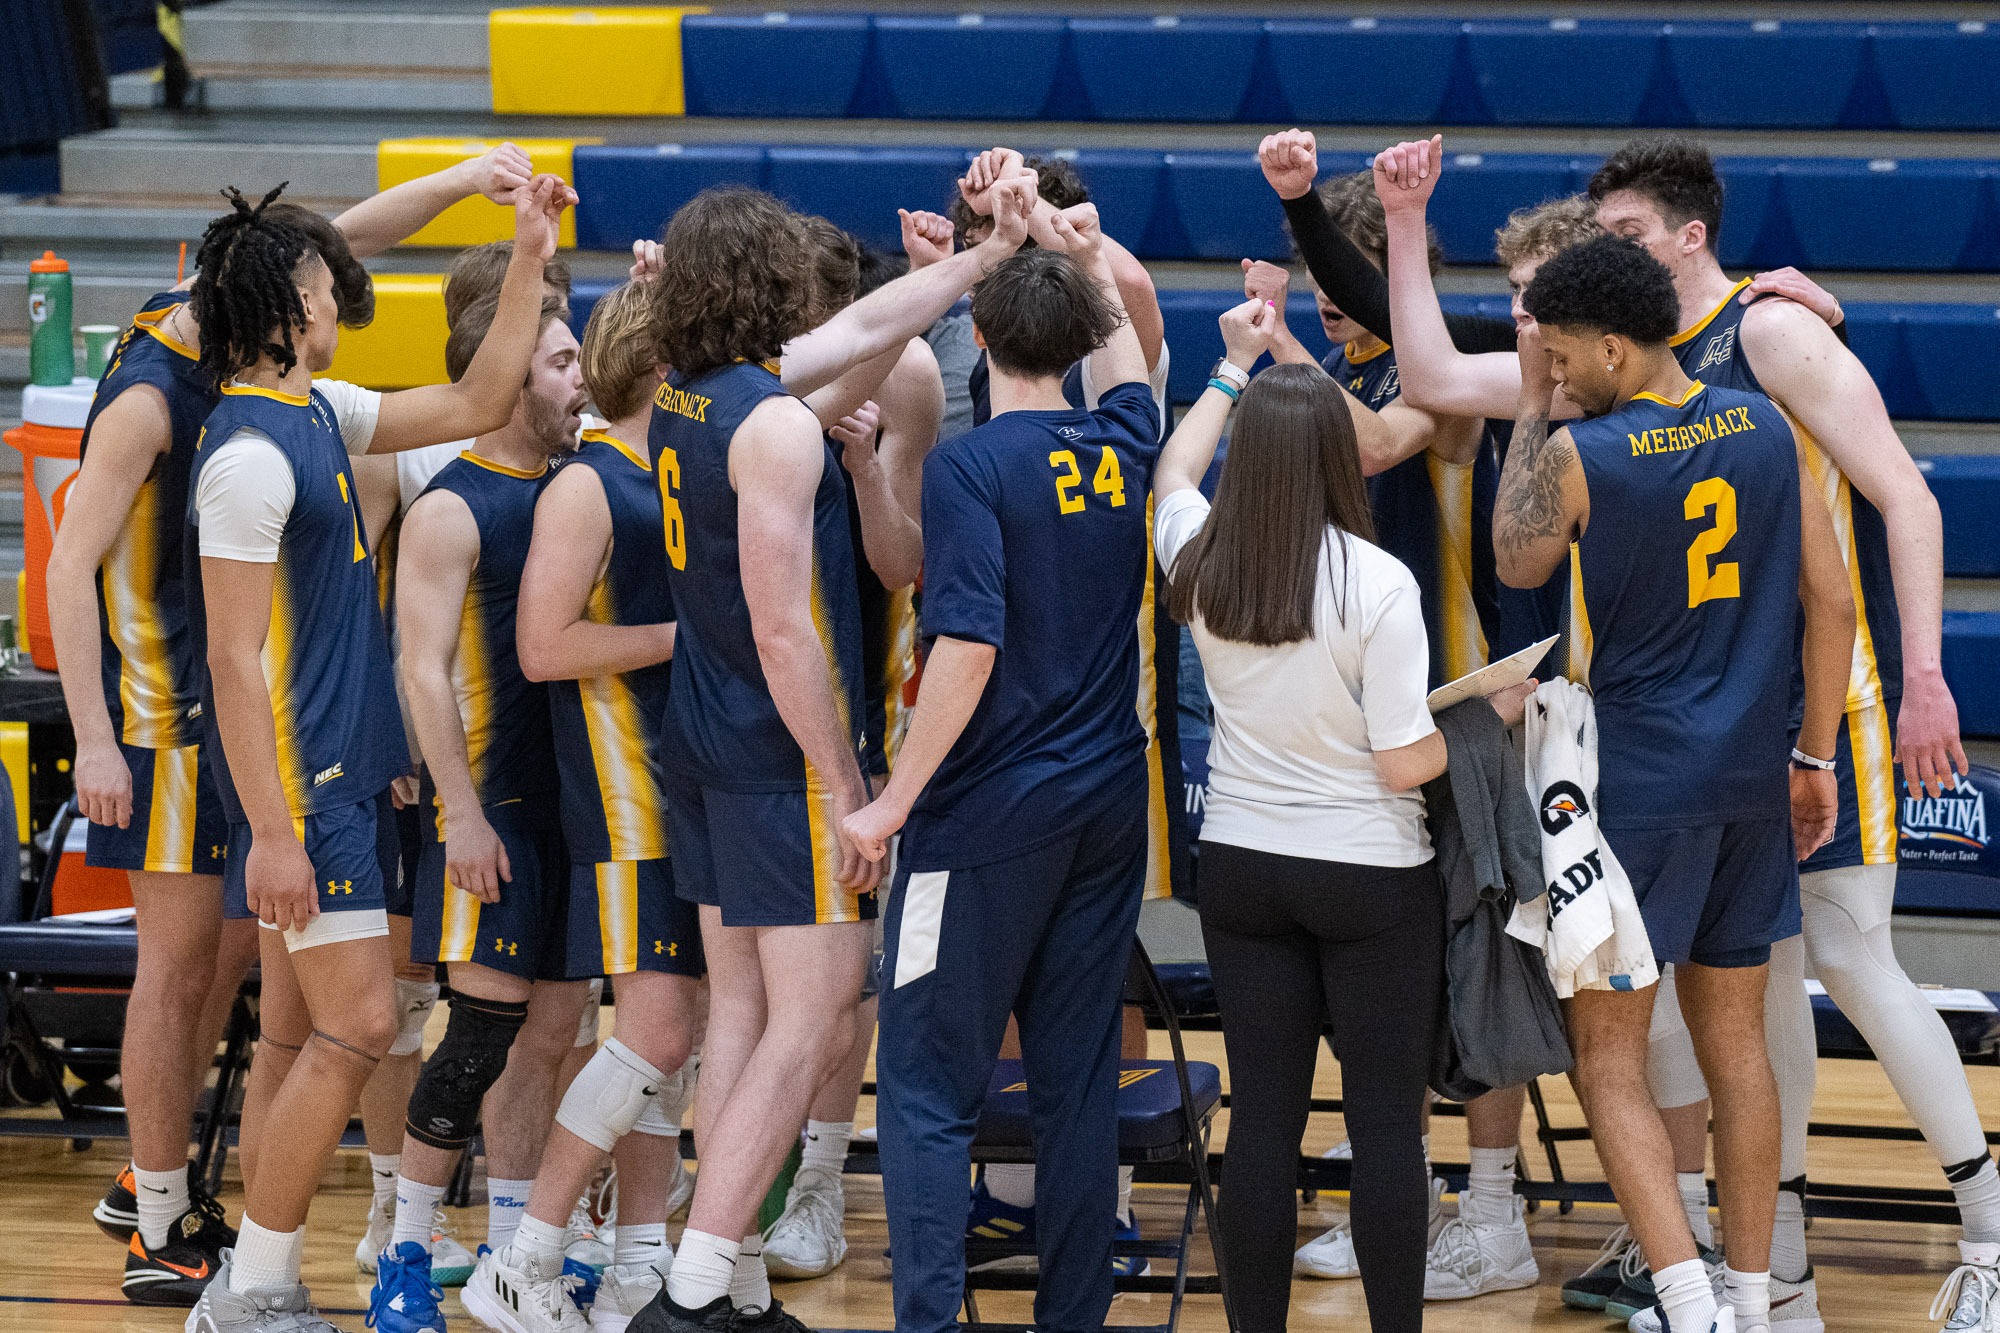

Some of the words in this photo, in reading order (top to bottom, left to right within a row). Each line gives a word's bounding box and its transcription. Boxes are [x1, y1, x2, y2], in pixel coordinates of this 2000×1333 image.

[1628, 406, 1756, 456] MERRIMACK
[1048, 445, 1126, 515] 24
[658, 446, 687, 571] 6
[1683, 476, 1740, 609] 2
[314, 761, 342, 785] NEC
[1903, 791, 1988, 846] UAFINA
[1929, 849, 1957, 862] Perfect
[1958, 850, 1979, 861] Taste
